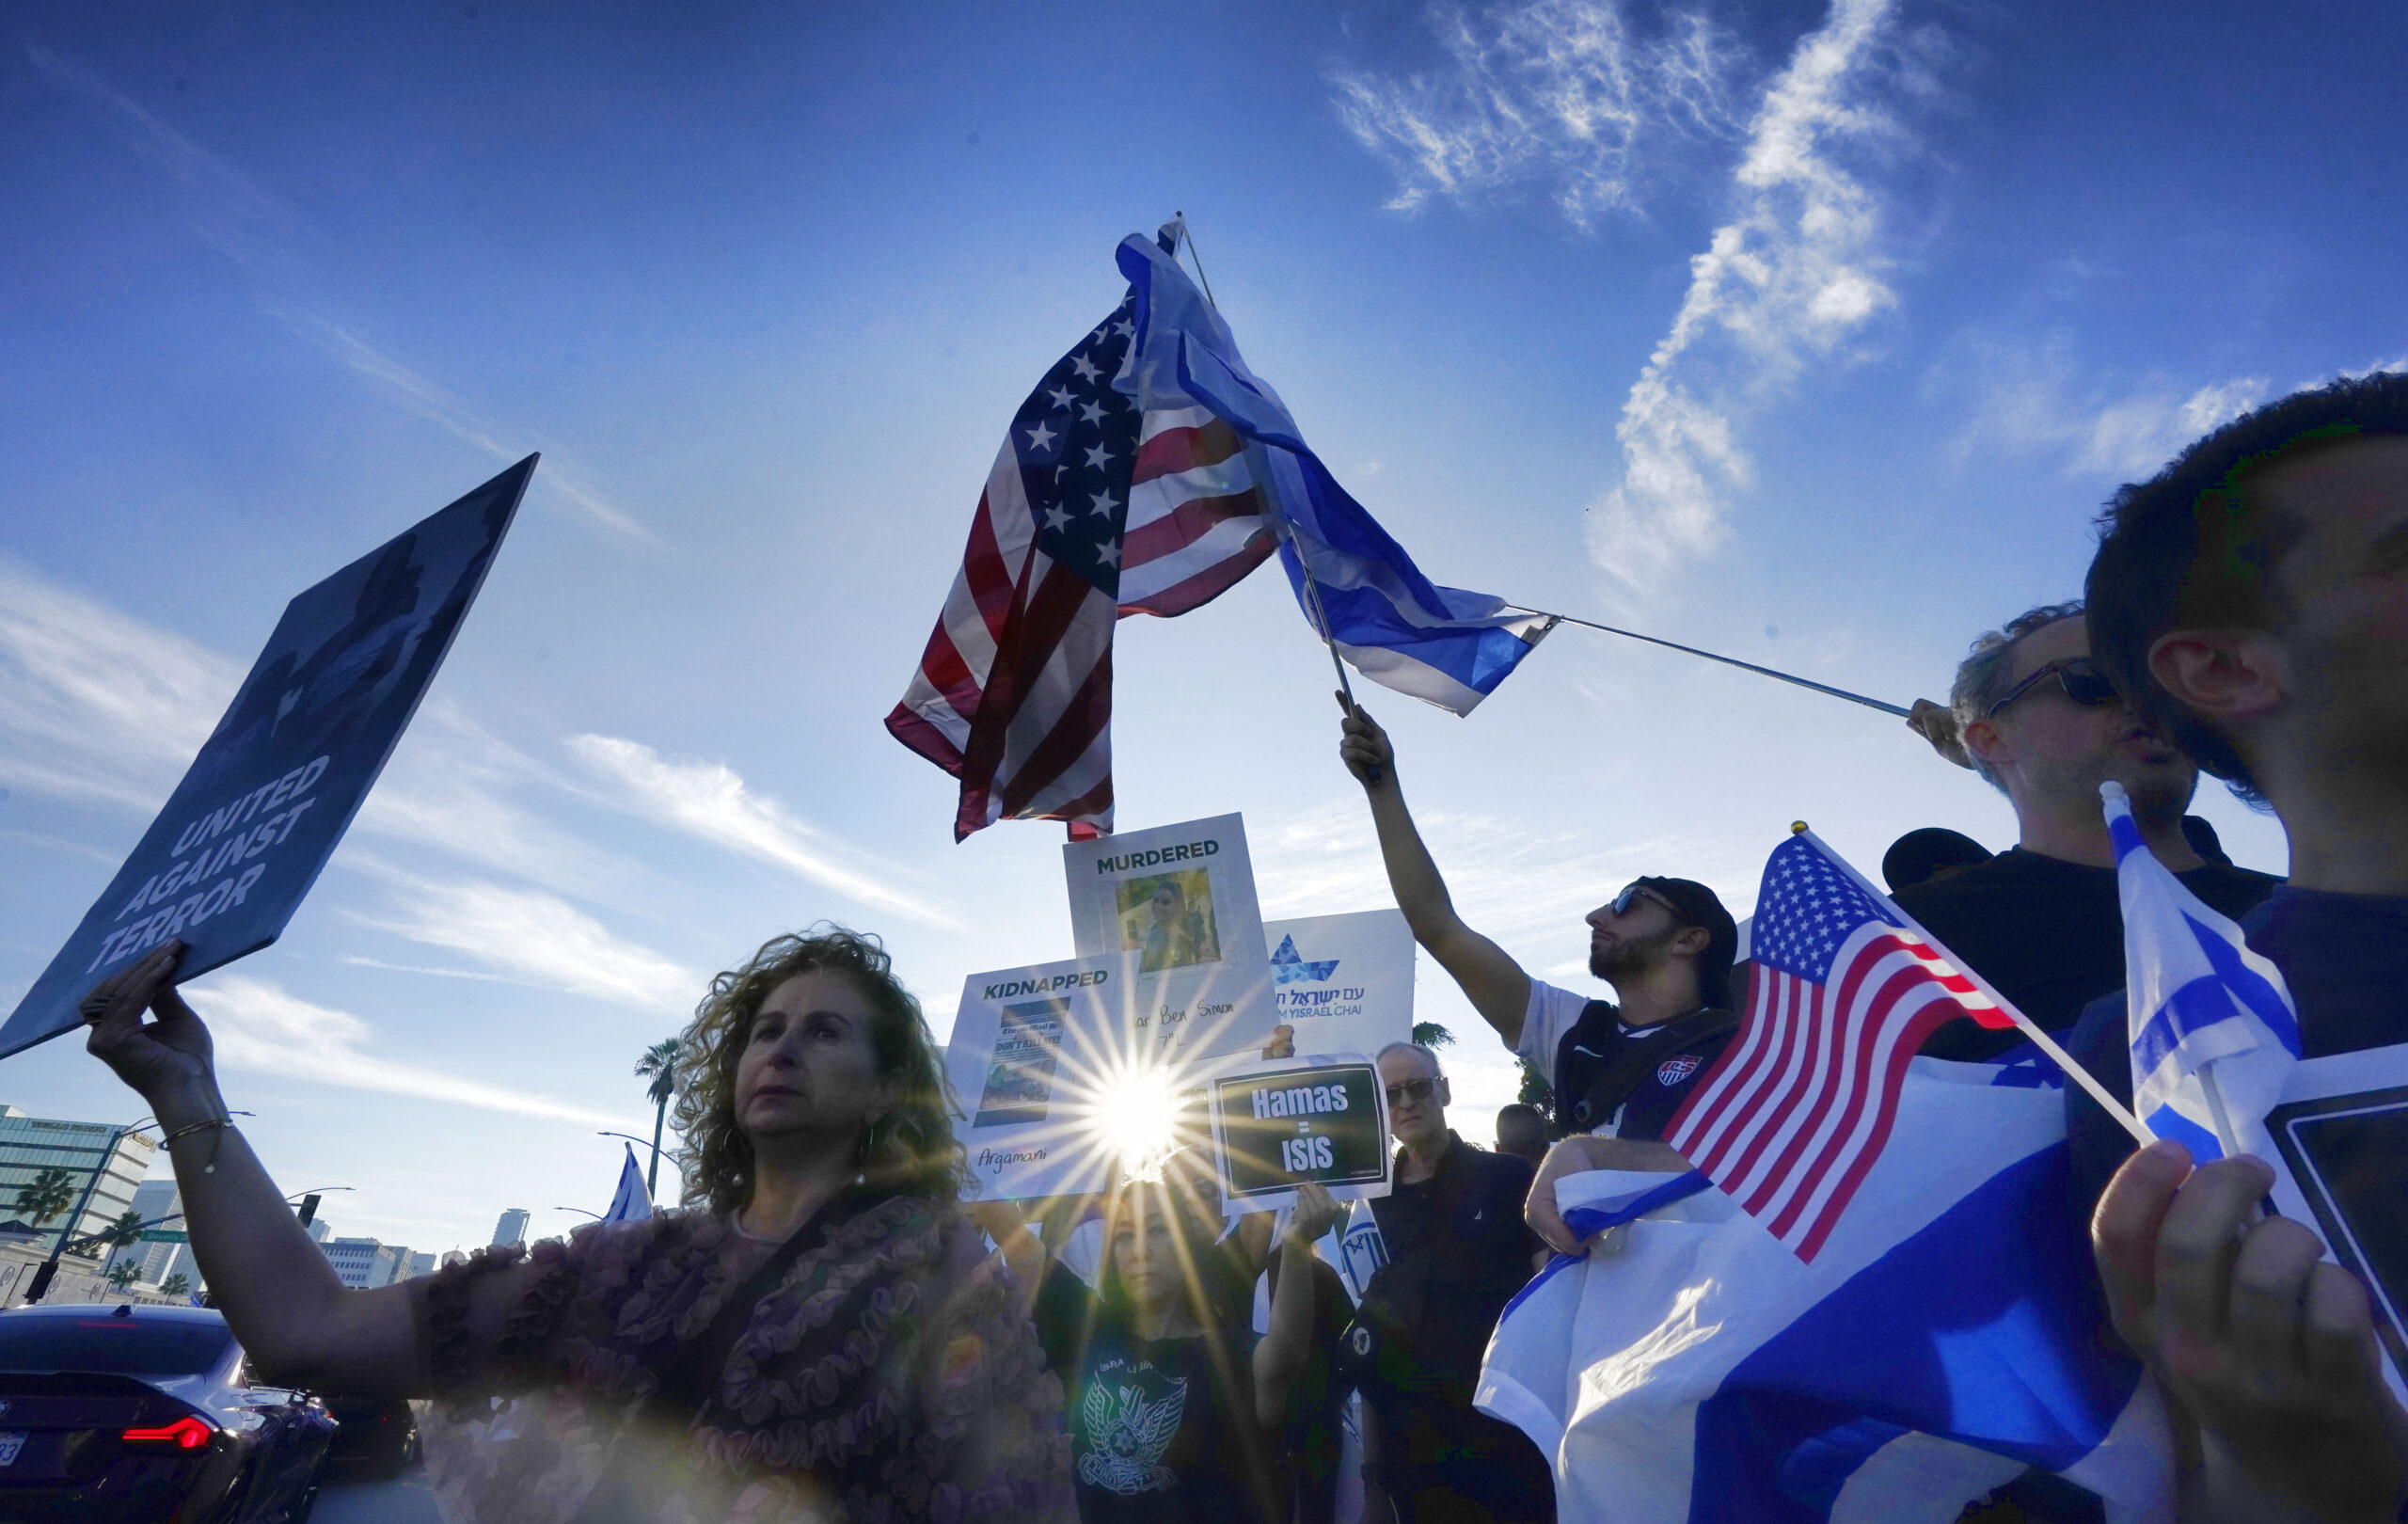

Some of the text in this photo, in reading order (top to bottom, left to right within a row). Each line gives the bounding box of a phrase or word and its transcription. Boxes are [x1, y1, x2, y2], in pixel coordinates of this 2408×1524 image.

[170, 754, 329, 858] UNITED
[114, 797, 316, 922] AGAINST
[1097, 839, 1220, 874] MURDERED
[86, 863, 265, 975] TERROR
[983, 970, 1109, 1000] KIDNAPPED
[1275, 992, 1286, 1005] ח
[1342, 987, 1365, 1001] עם
[1160, 1004, 1187, 1025] Ben
[1196, 999, 1234, 1017] Simon
[1278, 1005, 1362, 1019] M YISRAEL CHAI
[1251, 1085, 1349, 1119] Hamas
[977, 1147, 1047, 1175] Argamani
[1281, 1135, 1334, 1173] ISIS
